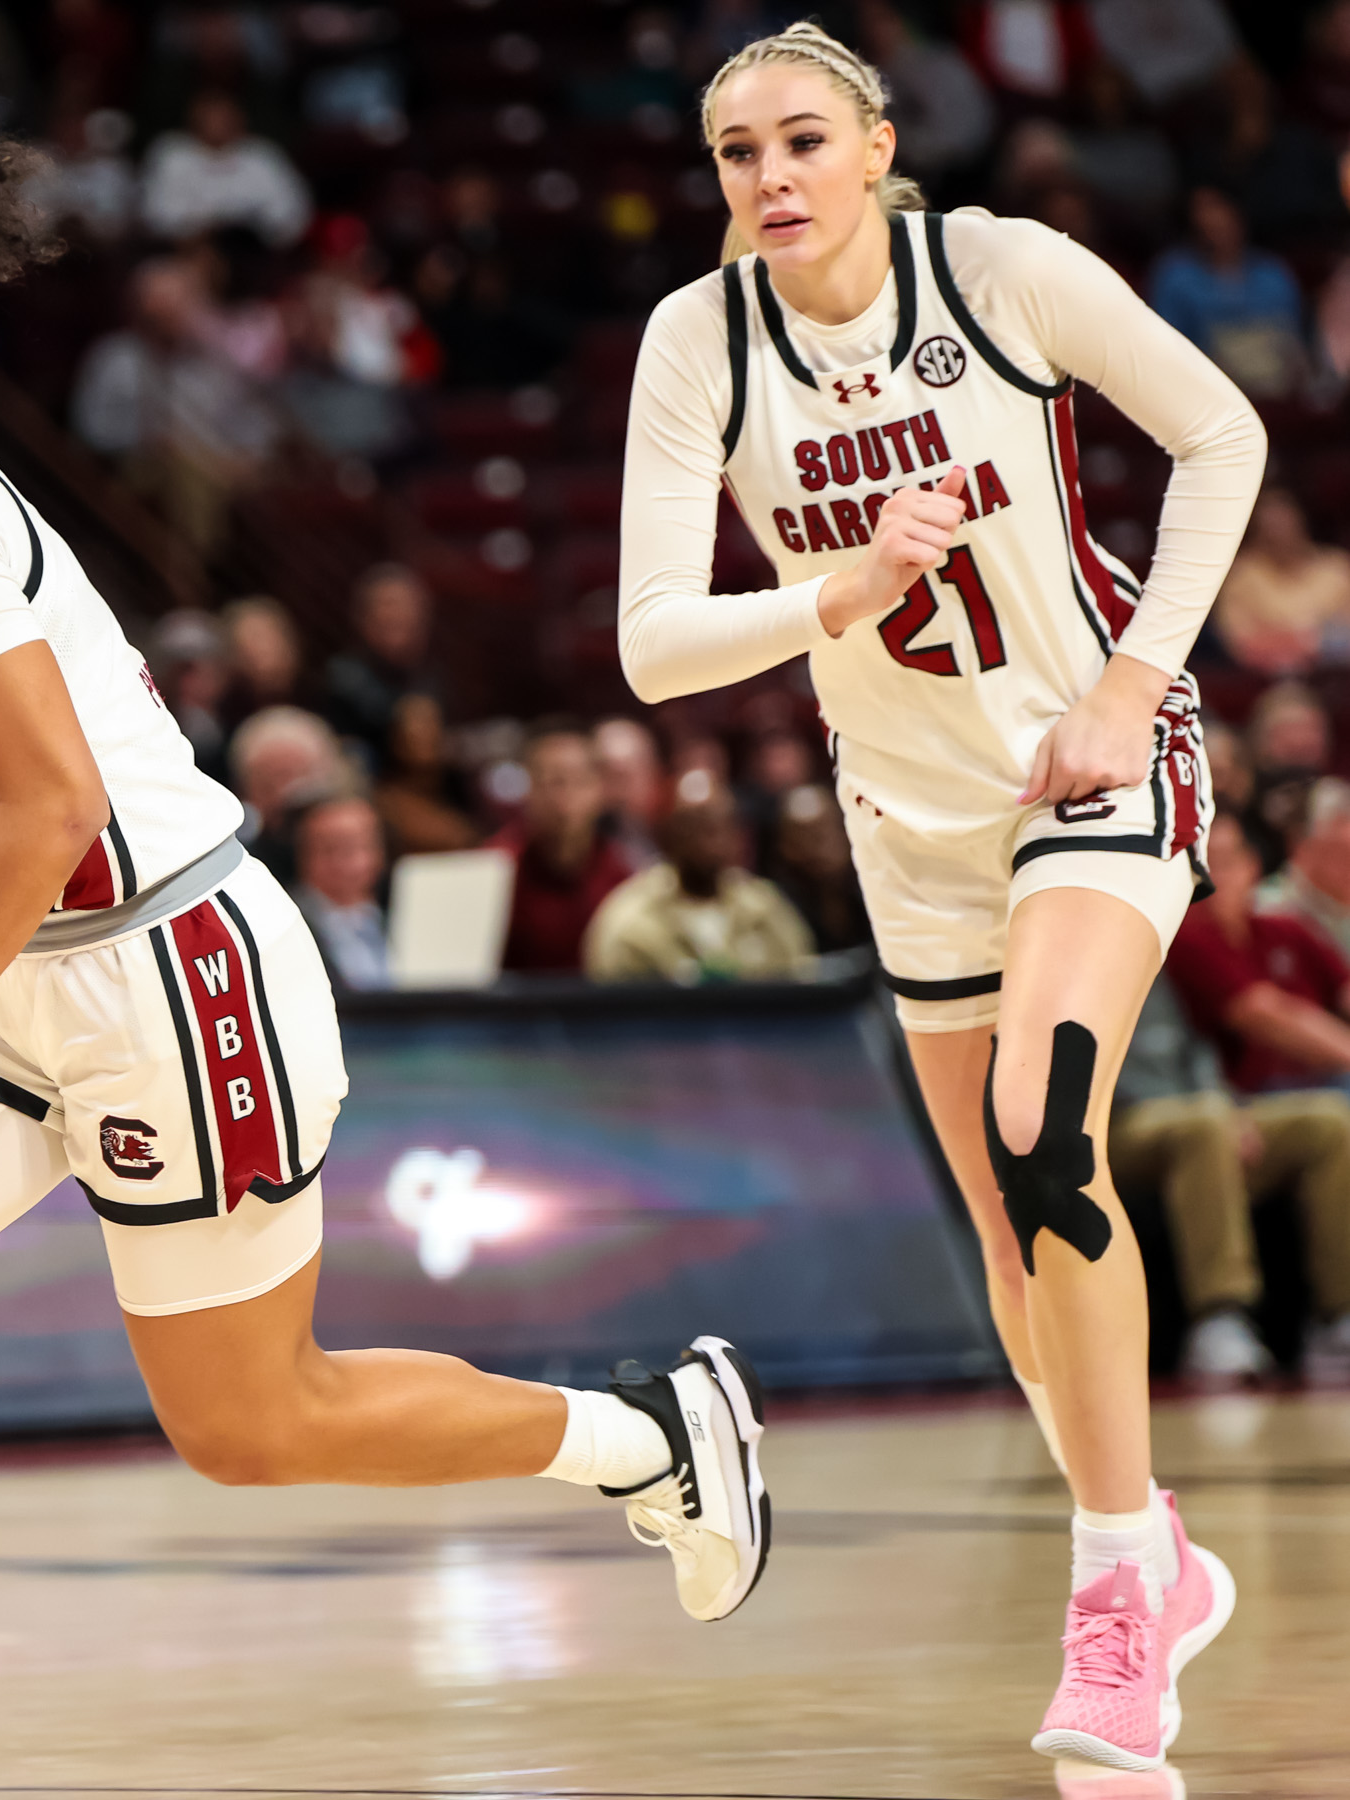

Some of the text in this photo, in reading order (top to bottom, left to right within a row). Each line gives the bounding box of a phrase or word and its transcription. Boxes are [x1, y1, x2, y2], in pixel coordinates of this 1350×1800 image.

[916, 338, 965, 386] SEC
[794, 408, 952, 492] SOUTH
[772, 459, 1012, 554] CAROA
[877, 543, 1008, 677] 21
